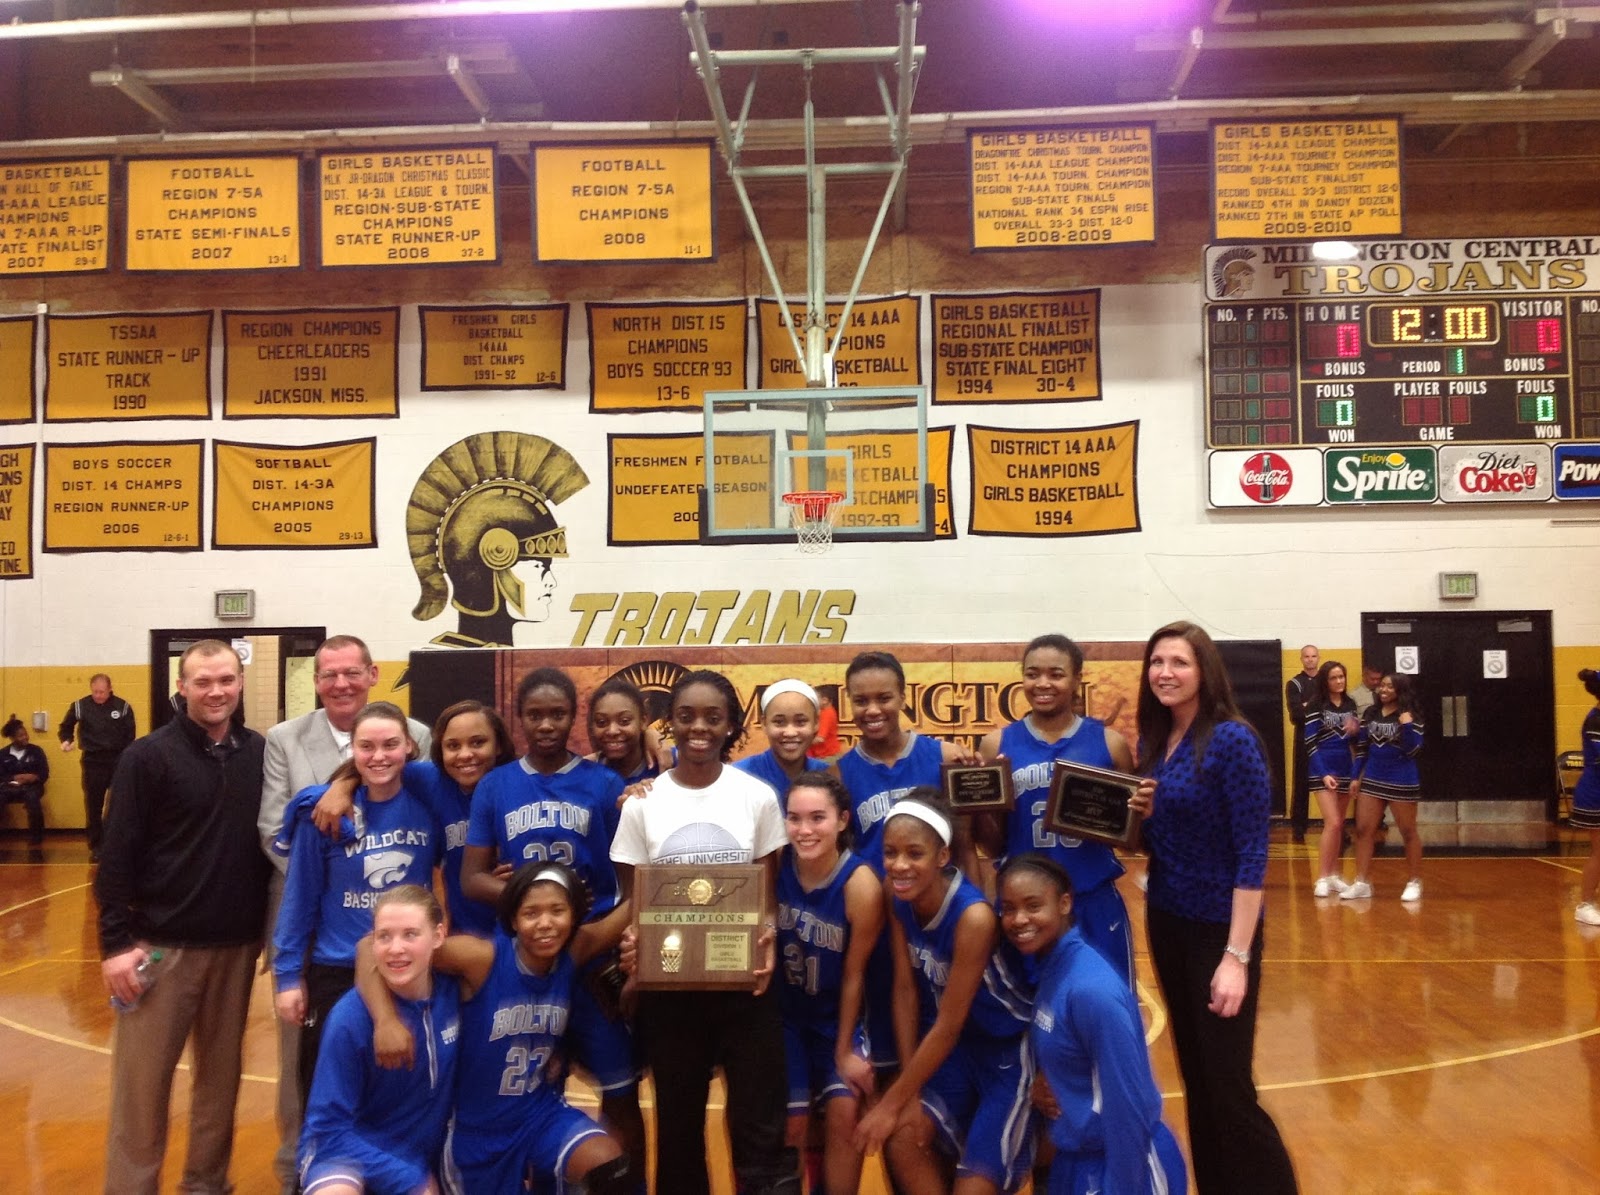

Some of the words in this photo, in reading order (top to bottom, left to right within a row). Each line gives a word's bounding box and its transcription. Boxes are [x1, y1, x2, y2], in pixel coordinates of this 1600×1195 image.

[981, 132, 1028, 146] GIRLS
[1036, 128, 1142, 144] BASKETBALL
[1224, 125, 1271, 139] GIRLS
[1280, 122, 1387, 137] BASKETBALL
[328, 157, 373, 171] GIRLS
[382, 154, 486, 168] BASKETBALL
[581, 159, 666, 172] FOOTBALL
[1049, 156, 1089, 168] LEAGUE
[6, 164, 103, 180] BASKETBALL
[171, 166, 254, 180] FOOTBALL
[401, 169, 448, 182] CHRISTMAS
[455, 168, 491, 181] CLASSIC
[162, 188, 218, 201] REGION
[226, 187, 263, 200] 7-5A
[394, 185, 433, 198] LEAGUE
[572, 184, 628, 197] REGION
[637, 182, 674, 196] 7-5A
[48, 194, 107, 208] LEAGUE
[1076, 193, 1116, 204] FINALS
[168, 208, 258, 220] CHAMPIONS
[579, 207, 669, 221] CHAMPIONS
[68, 224, 102, 236] R-UP
[363, 216, 454, 230] CHAMPIONS
[994, 220, 1042, 230] OVERALL
[1264, 221, 1352, 235] 2009-2010
[135, 228, 182, 241] STATE
[192, 226, 291, 240] SEMI-FINALS
[335, 232, 382, 246] STATE
[392, 230, 481, 244] RUNNER-UP
[604, 232, 646, 246] 2008
[1016, 229, 1113, 243] 2008-2009
[37, 240, 104, 253] FINALIST
[387, 246, 430, 260] 2008
[461, 248, 485, 258] 37-2
[684, 245, 702, 254] 11-1
[1464, 238, 1599, 258] CENTRAL
[8, 256, 46, 268] 2007
[192, 246, 233, 260] 2007
[268, 254, 288, 265] 13-1
[1274, 258, 1587, 296] TROJANS
[941, 304, 984, 321] GIRLS
[989, 302, 1090, 320] BASKETBALL
[1216, 308, 1237, 322] NO.
[1246, 308, 1254, 321] F
[1263, 307, 1288, 321] PTS.
[1304, 306, 1361, 322] HOME
[1502, 301, 1563, 318] VISITOR
[452, 314, 498, 326] FRESHMEN
[511, 313, 536, 325] GIRLS
[612, 316, 662, 332] NORTH
[672, 316, 706, 330] DIST.
[708, 315, 726, 330] 15
[851, 312, 866, 327] 14
[871, 308, 900, 326] AAA
[1392, 308, 1488, 342] 12:00
[110, 325, 157, 340] TSSAA
[240, 322, 293, 338] REGION
[303, 320, 382, 336] CHAMPIONS
[468, 328, 524, 340] BASKETBALL
[942, 322, 1017, 339] REGIONAL
[1022, 320, 1090, 336] FINALIST
[1537, 318, 1560, 353] 0
[628, 338, 708, 354] CHAMPIONS
[1336, 323, 1361, 358] 0
[258, 343, 370, 360] CHEERLEADERS
[938, 341, 1014, 358] SUB-STATE
[1019, 339, 1093, 355] CHAMPION
[58, 352, 100, 367] STATE
[106, 350, 164, 366] RUNNER
[490, 354, 525, 366] CHAMPS
[1504, 358, 1545, 372] BONUS
[294, 366, 326, 381] 1991
[608, 363, 644, 379] BOYS
[654, 362, 709, 378] SOCCER
[946, 361, 990, 376] STATE
[994, 360, 1037, 376] FINAL
[1042, 358, 1087, 374] EIGHT
[1324, 361, 1366, 376] BONUS
[1402, 360, 1441, 374] PERIOD
[106, 372, 150, 388] TRACK
[536, 371, 556, 383] 12-6
[656, 386, 690, 401] 13-6
[957, 380, 994, 395] 1994
[1036, 378, 1076, 393] 30-4
[1316, 384, 1354, 398] FOULS
[1394, 382, 1440, 396] PLAYER
[1448, 381, 1488, 395] FOULS
[1516, 379, 1556, 394] FOULS
[113, 394, 146, 410] 1990
[332, 387, 368, 404] MISS.
[1336, 400, 1353, 426] 0
[1537, 396, 1554, 420] 0
[1328, 429, 1355, 442] WON
[1418, 427, 1454, 441] GAME
[1534, 425, 1562, 438] WON
[846, 444, 892, 460] GIRLS
[990, 440, 1060, 458] DISTRICT
[1065, 438, 1081, 454] 14
[1084, 436, 1116, 452] AAA
[73, 458, 109, 470] BOYS
[118, 458, 172, 470] SOCCER
[255, 457, 332, 470] SOFTBALL
[614, 454, 688, 468] FRESHMEN
[1362, 454, 1386, 466] Enjoy
[1478, 452, 1520, 470] Diet
[1006, 460, 1101, 480] CHAMPIONS
[62, 480, 96, 492] DIST.
[104, 480, 118, 491] 14
[125, 478, 182, 490] CHAMPS
[252, 479, 288, 490] DIST.
[294, 478, 335, 490] 14-3A
[1333, 456, 1430, 500] Sprite
[1459, 465, 1524, 493] Coke
[615, 482, 705, 496] UNDEFEATED
[713, 482, 768, 494] SEASON
[982, 484, 1026, 502] GIRLS
[1028, 478, 1124, 502] BASKETBALL
[54, 502, 104, 514] REGION
[110, 500, 190, 513] RUNNER-UP
[252, 500, 335, 512] CHAMPIONS
[1034, 510, 1073, 526] 1994
[103, 524, 140, 535] 2006
[274, 522, 312, 534] 2005
[164, 534, 190, 542] 12-6-1
[338, 532, 364, 542] 29-13
[570, 589, 856, 646] TROJANS
[504, 800, 590, 840] BOLTON
[688, 850, 750, 864] UNIVERSITY
[654, 914, 745, 923] CHAMPIONS
[784, 944, 820, 996] 21
